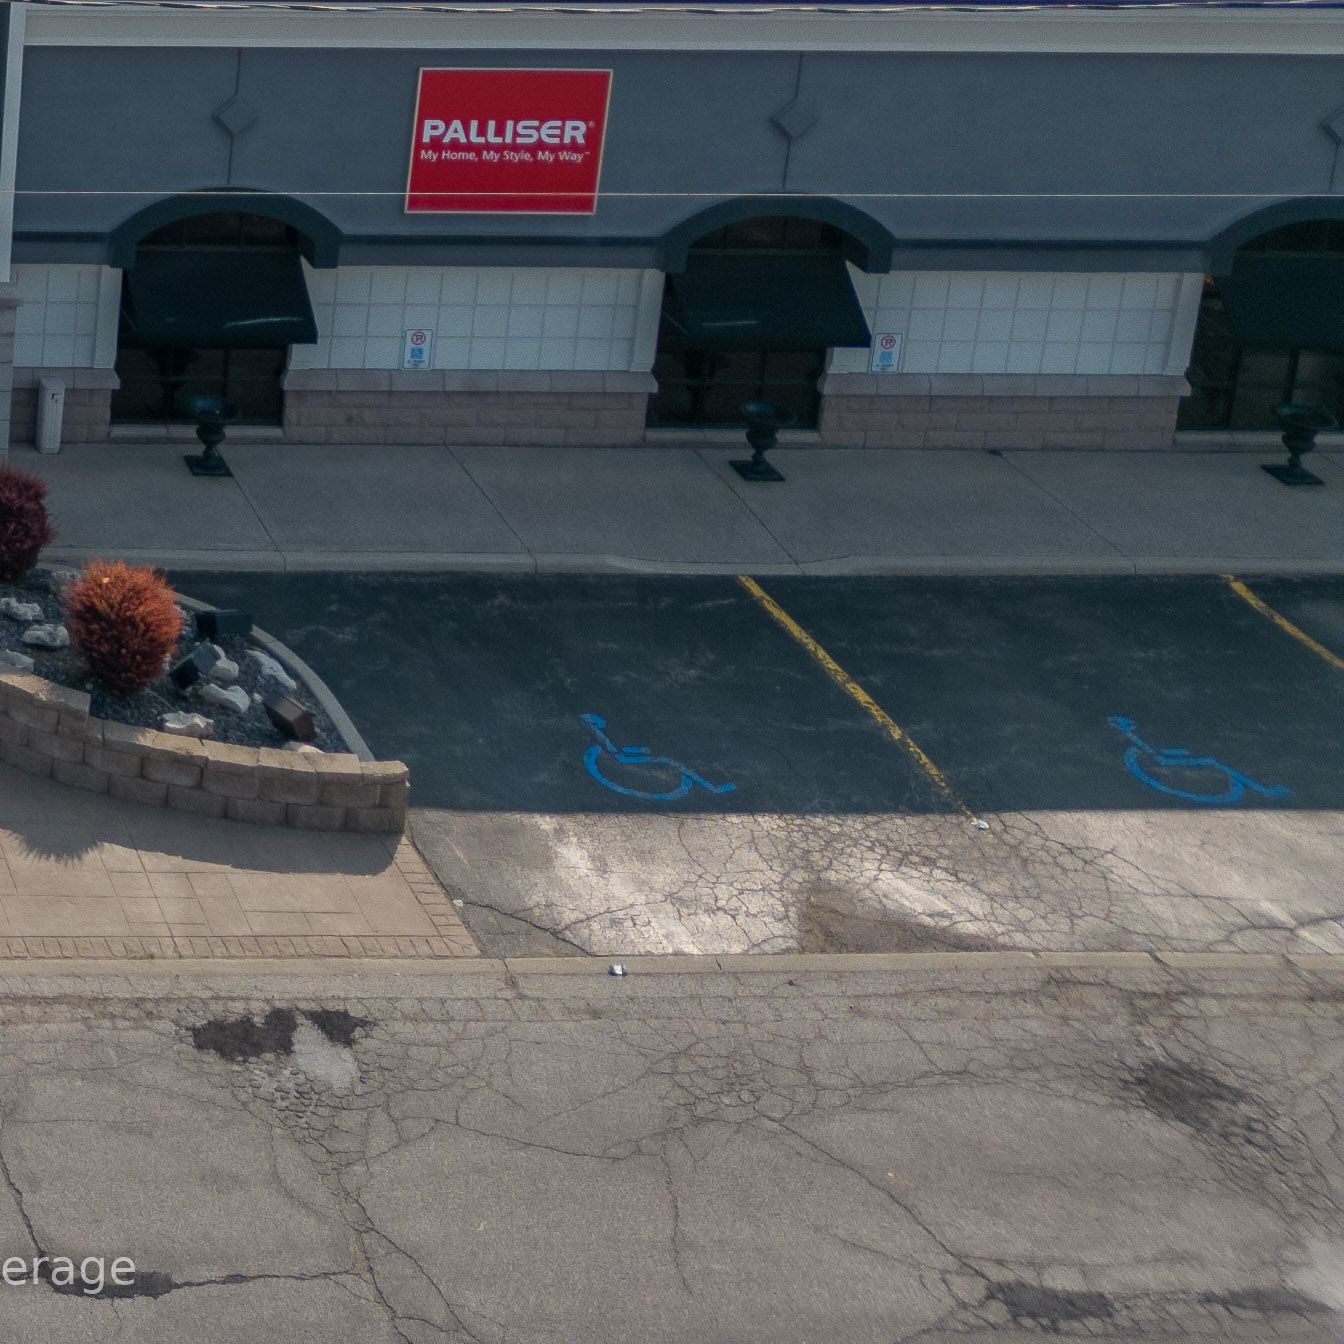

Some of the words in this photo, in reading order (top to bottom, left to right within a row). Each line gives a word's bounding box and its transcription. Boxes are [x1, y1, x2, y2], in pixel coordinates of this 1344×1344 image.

[422, 119, 587, 144] PALLISER
[420, 149, 437, 162] My
[442, 149, 478, 162] Home,
[482, 149, 499, 163] My
[503, 149, 533, 163] Style,
[537, 150, 554, 163] My
[559, 150, 584, 164] Way
